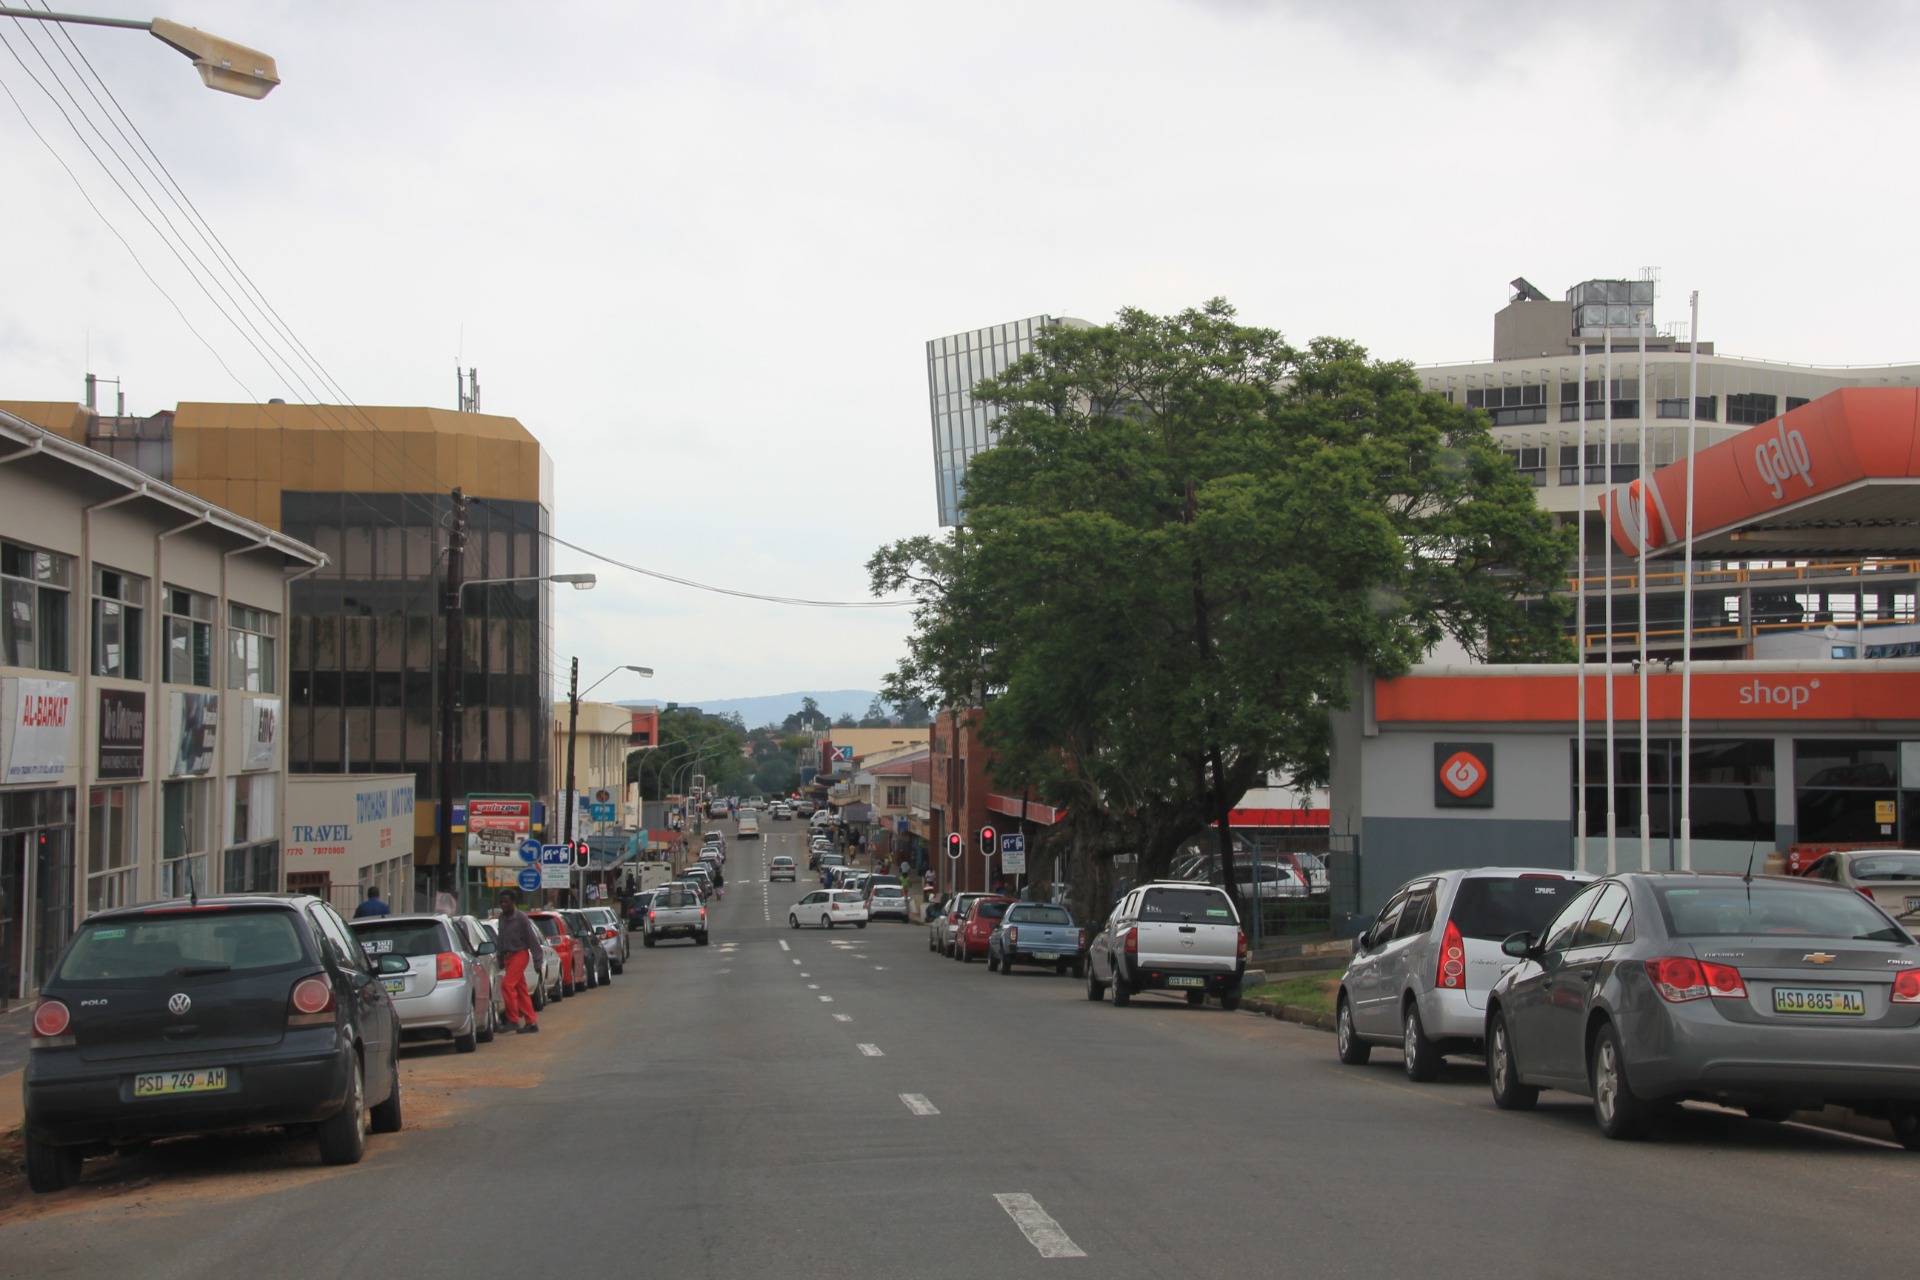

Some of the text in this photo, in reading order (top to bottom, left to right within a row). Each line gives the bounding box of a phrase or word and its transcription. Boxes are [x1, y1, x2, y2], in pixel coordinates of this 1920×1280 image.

[1755, 419, 1814, 500] galp
[1739, 679, 1810, 710] shop
[23, 695, 69, 727] AL-BARKAT
[292, 825, 353, 842] TRAVEL
[1776, 992, 1860, 1011] HSD 885 AL
[137, 1070, 224, 1092] PSD 749 AM
